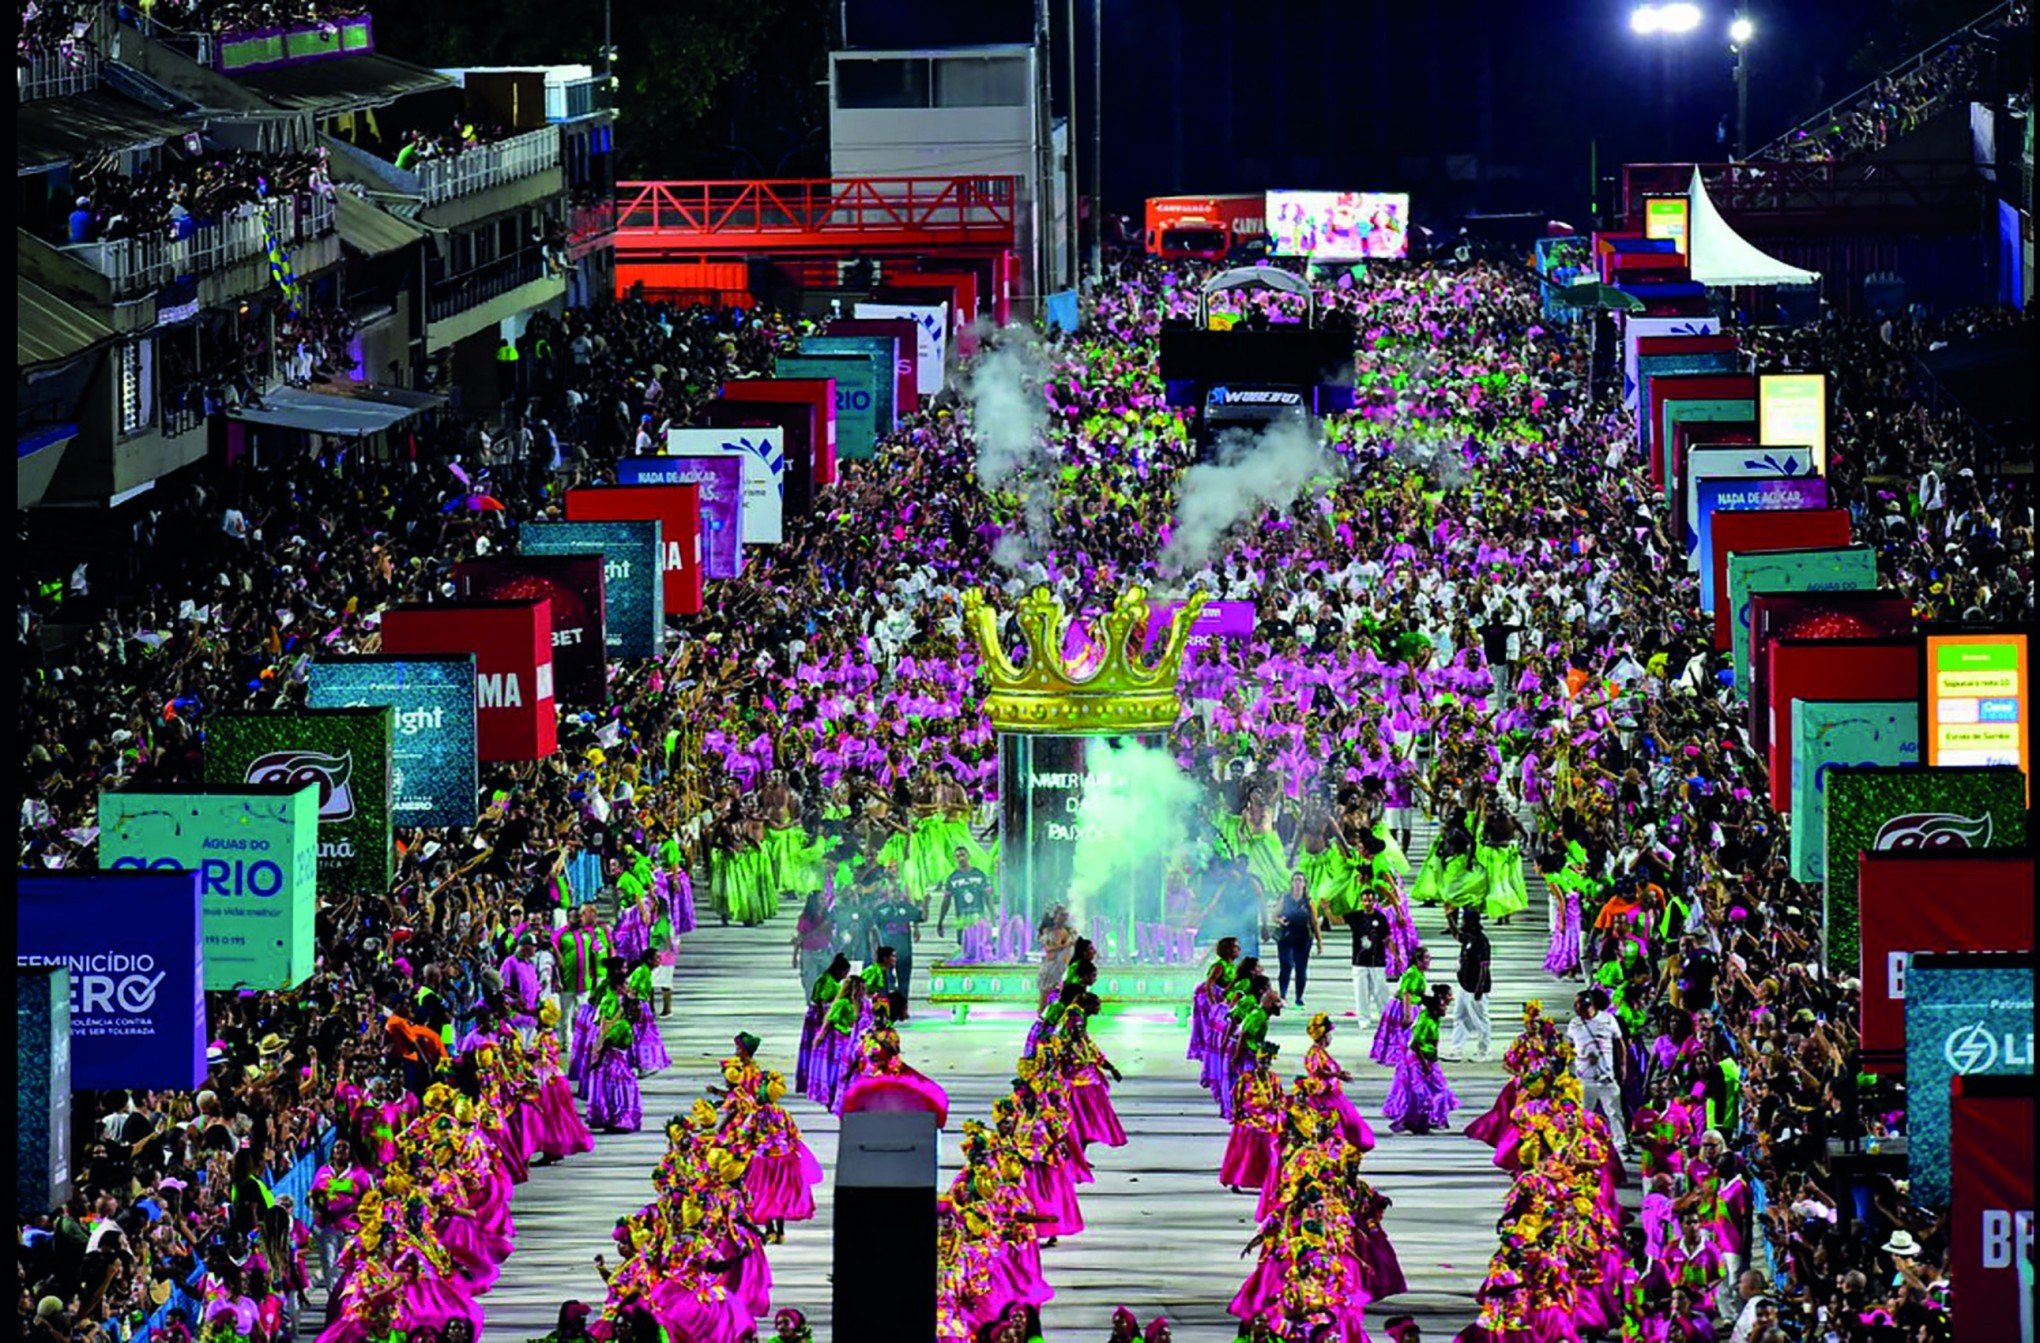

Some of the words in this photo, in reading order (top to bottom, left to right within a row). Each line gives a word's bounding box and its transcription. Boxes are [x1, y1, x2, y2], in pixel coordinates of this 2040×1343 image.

[1718, 493, 1745, 505] NADA
[1747, 492, 1760, 504] DE
[394, 706, 443, 735] ight
[250, 839, 269, 850] DO
[200, 858, 283, 898] RIO
[70, 975, 156, 1013] ERO
[115, 1018, 152, 1026] CONTRA
